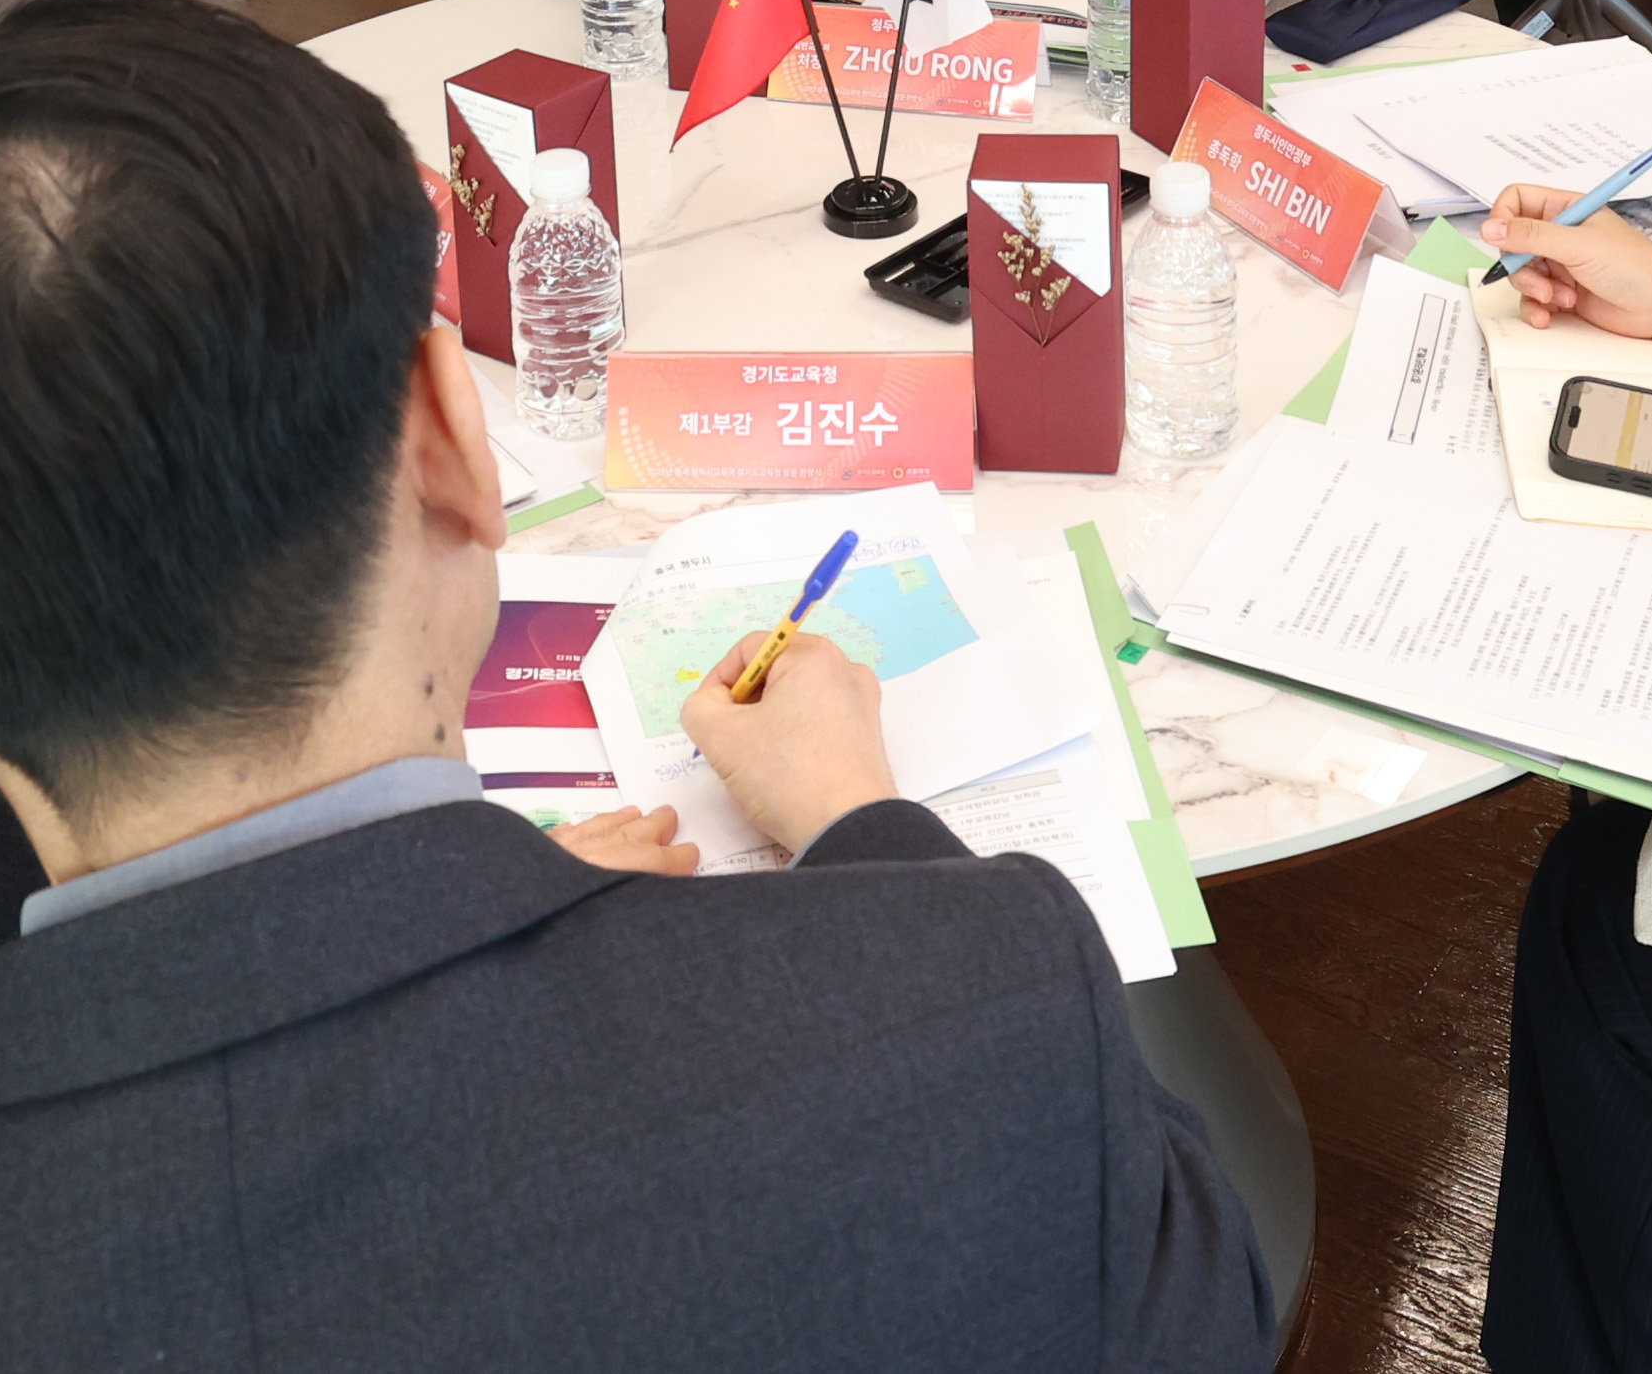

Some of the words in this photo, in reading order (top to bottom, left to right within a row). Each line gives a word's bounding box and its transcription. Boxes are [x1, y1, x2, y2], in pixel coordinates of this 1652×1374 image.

[842, 45, 925, 77] ZHOU
[930, 53, 1014, 84] RONG
[1252, 123, 1314, 168] 청두시인민정부
[1205, 138, 1243, 174] 총독학
[1244, 160, 1289, 208] SHI
[1284, 184, 1333, 237] BIN
[741, 365, 838, 385] 경기도교육청
[678, 412, 753, 437] 제1부감
[776, 400, 900, 447] 김진수
[680, 556, 712, 569] 청두시
